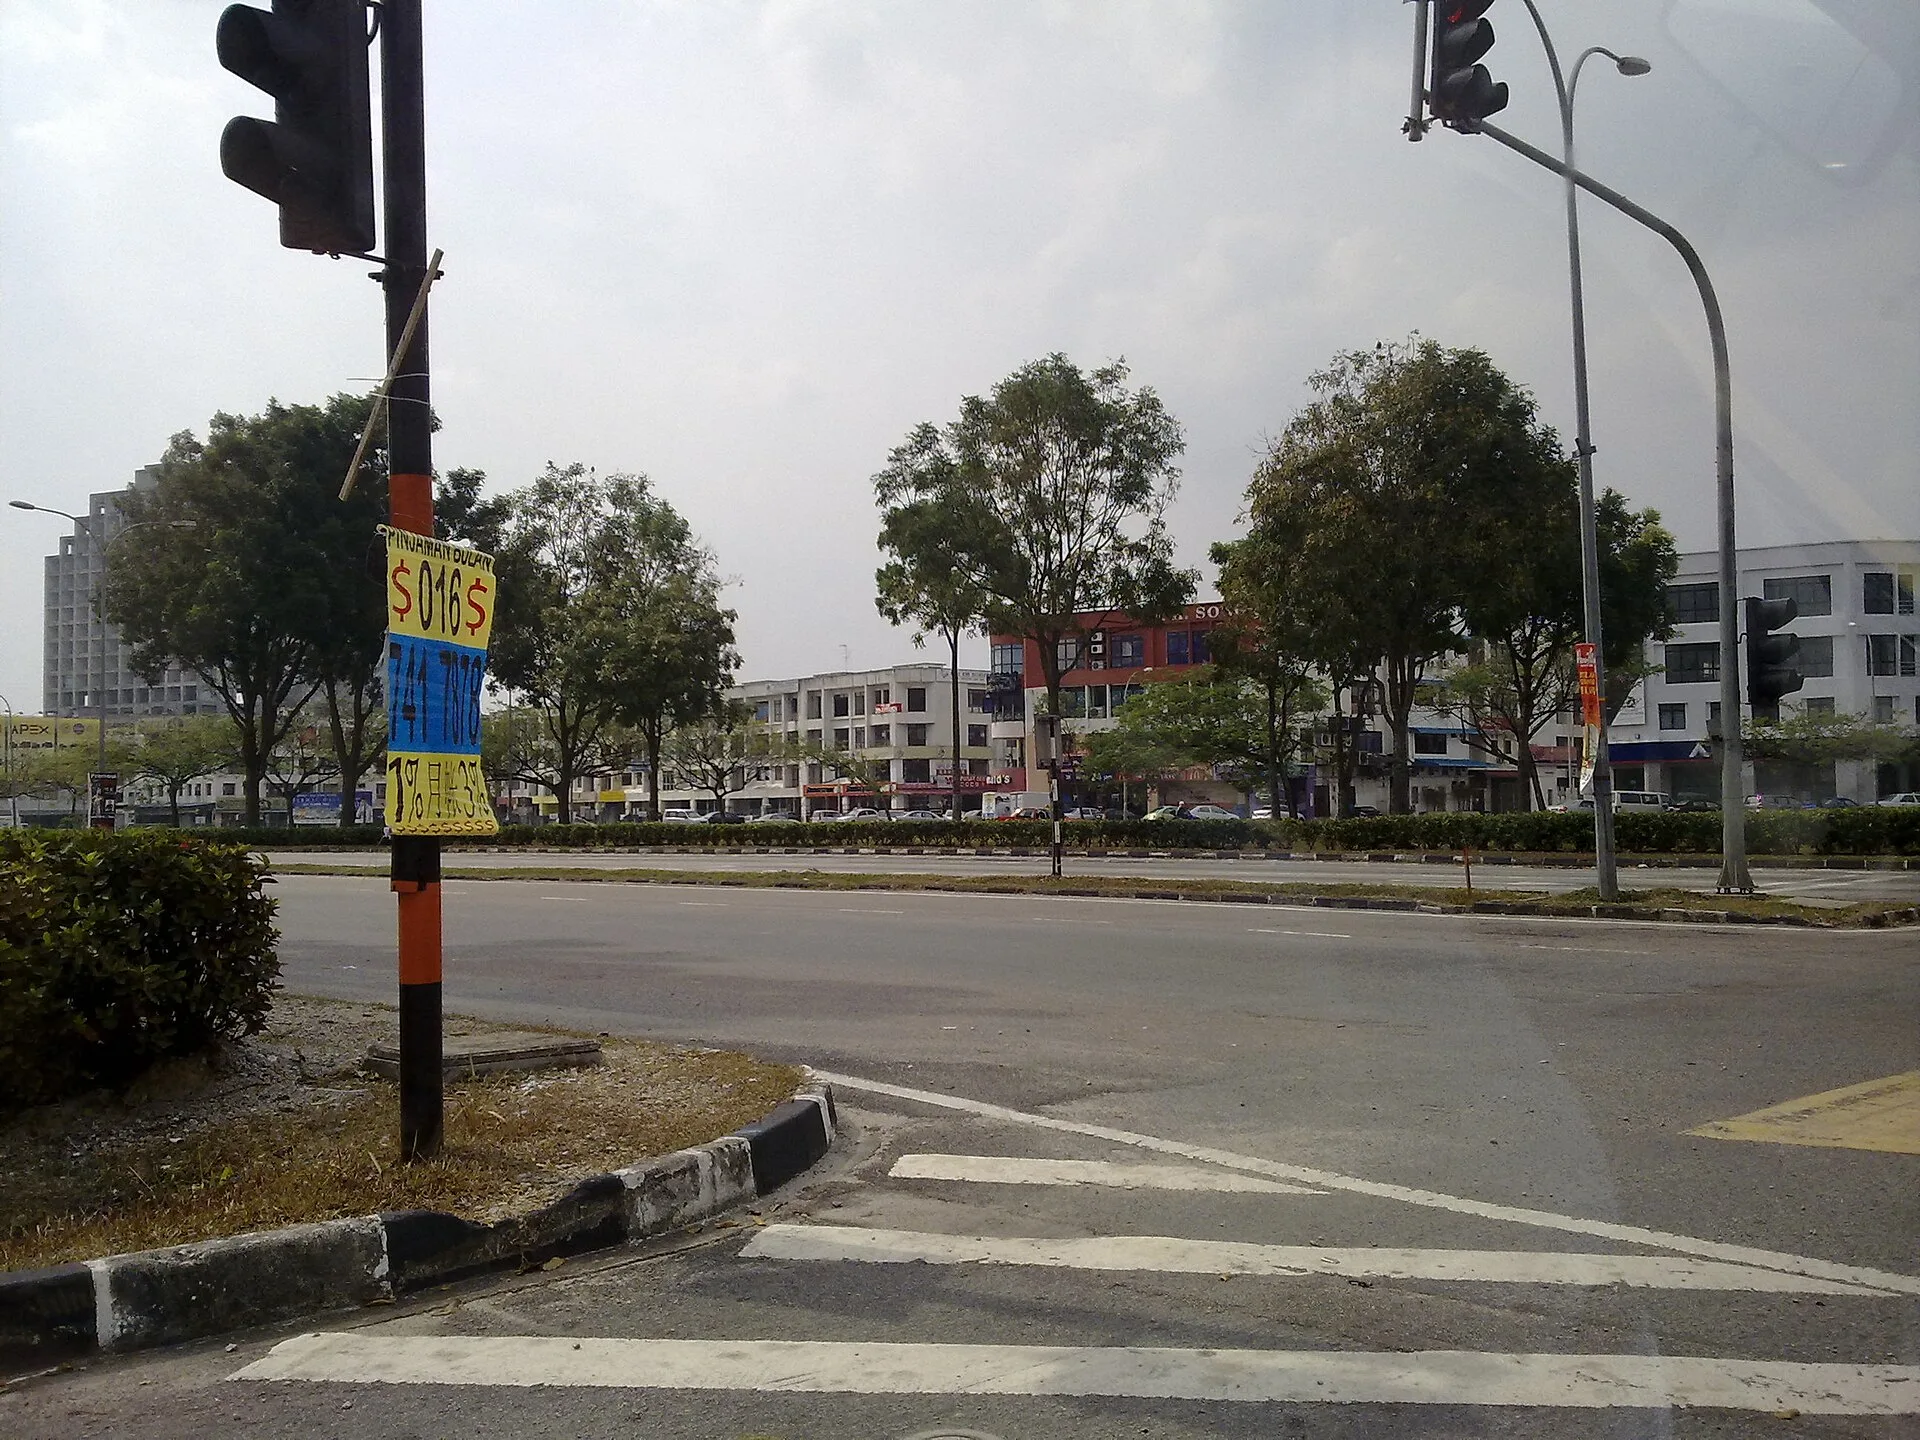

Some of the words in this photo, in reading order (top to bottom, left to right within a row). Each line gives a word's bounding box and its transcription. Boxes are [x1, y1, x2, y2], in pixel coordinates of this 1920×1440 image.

[390, 642, 427, 743] 741
[11, 724, 49, 734] APEX
[388, 757, 424, 824] 1%
